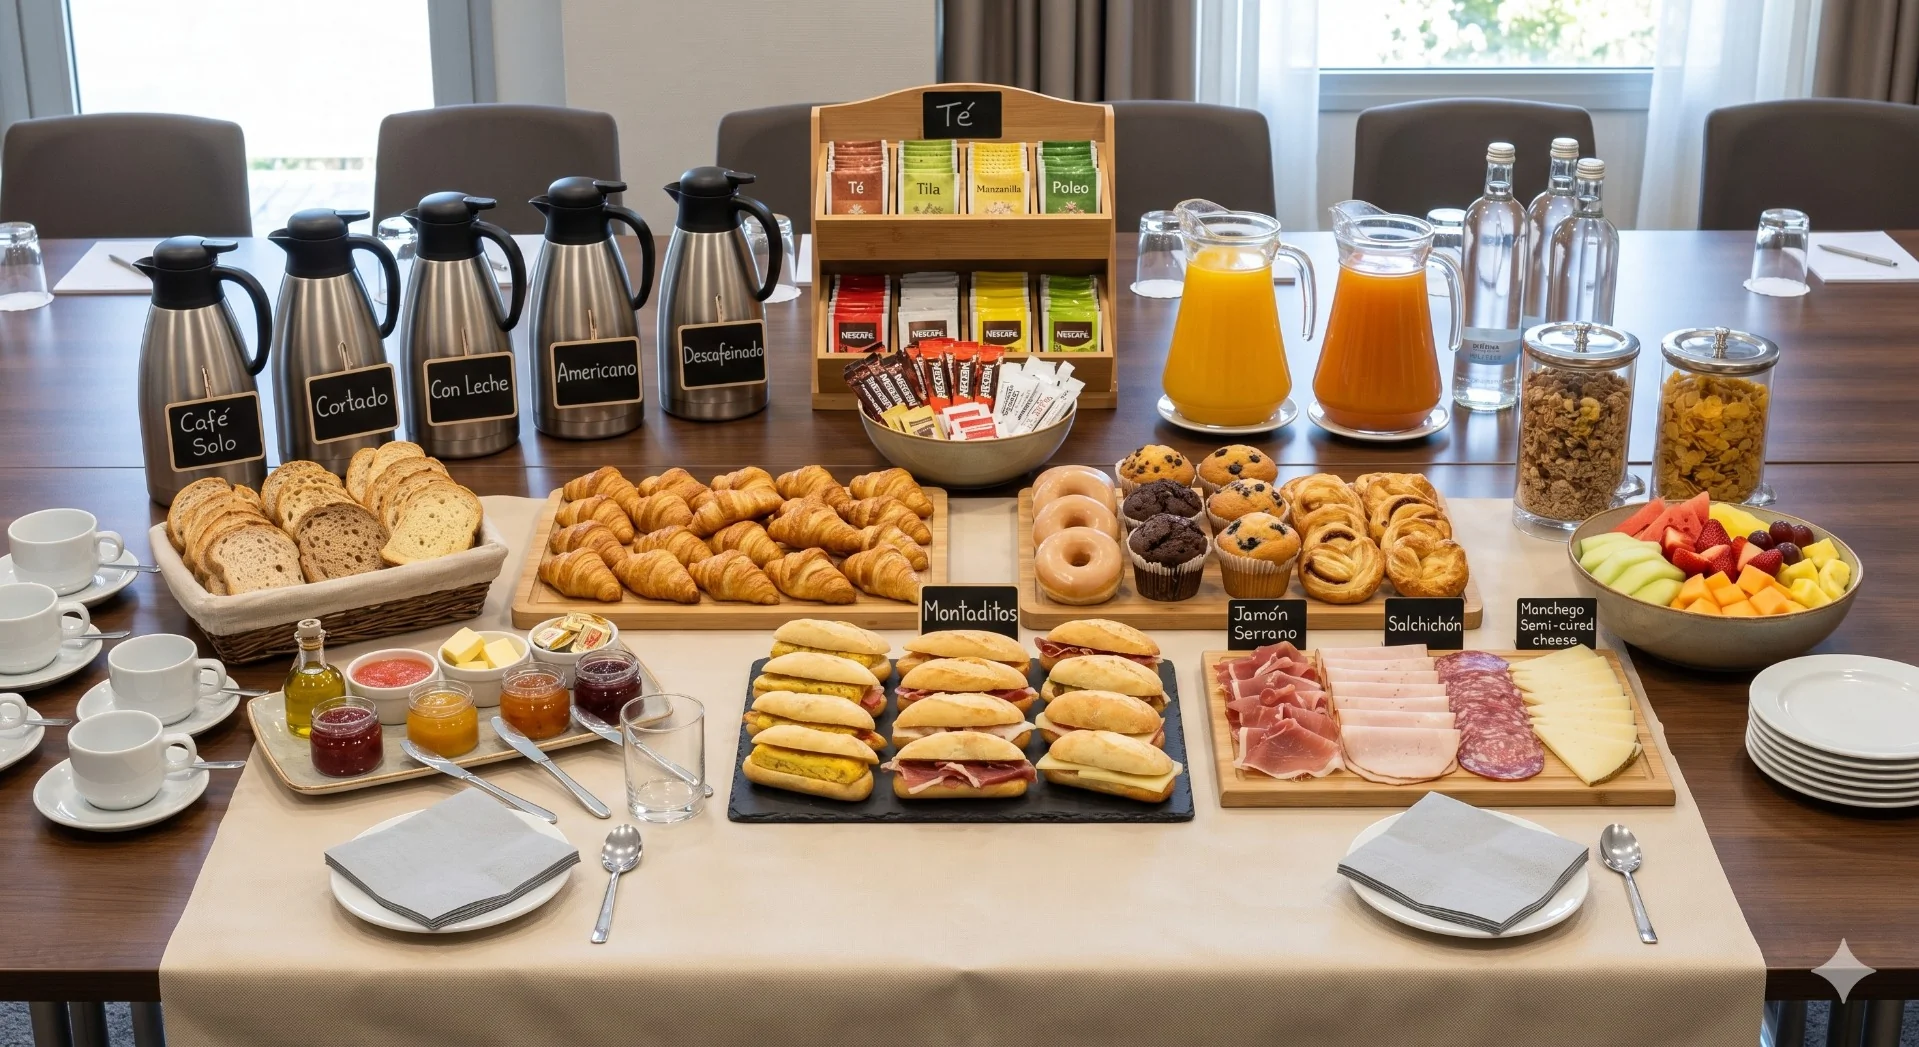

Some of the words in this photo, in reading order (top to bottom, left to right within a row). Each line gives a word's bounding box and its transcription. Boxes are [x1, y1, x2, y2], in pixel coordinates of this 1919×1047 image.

[936, 102, 975, 126] Té
[848, 181, 864, 194] Té
[916, 182, 940, 195] Tila
[976, 184, 1022, 193] Manzanilla
[1052, 181, 1089, 194] Poleo
[684, 341, 763, 365] Descafeinado
[558, 363, 636, 382] Americano
[431, 380, 459, 398] Con
[466, 374, 508, 394] Leche
[317, 387, 387, 417] Cortado
[180, 407, 231, 434] Café
[192, 434, 236, 457] Solo
[924, 600, 1018, 622] Montaditos
[1233, 605, 1288, 622] Jamón
[1521, 601, 1585, 619] Manchego
[1389, 615, 1461, 631] Salchichón
[1234, 625, 1298, 640] Serrano
[1532, 633, 1578, 646] cheese
